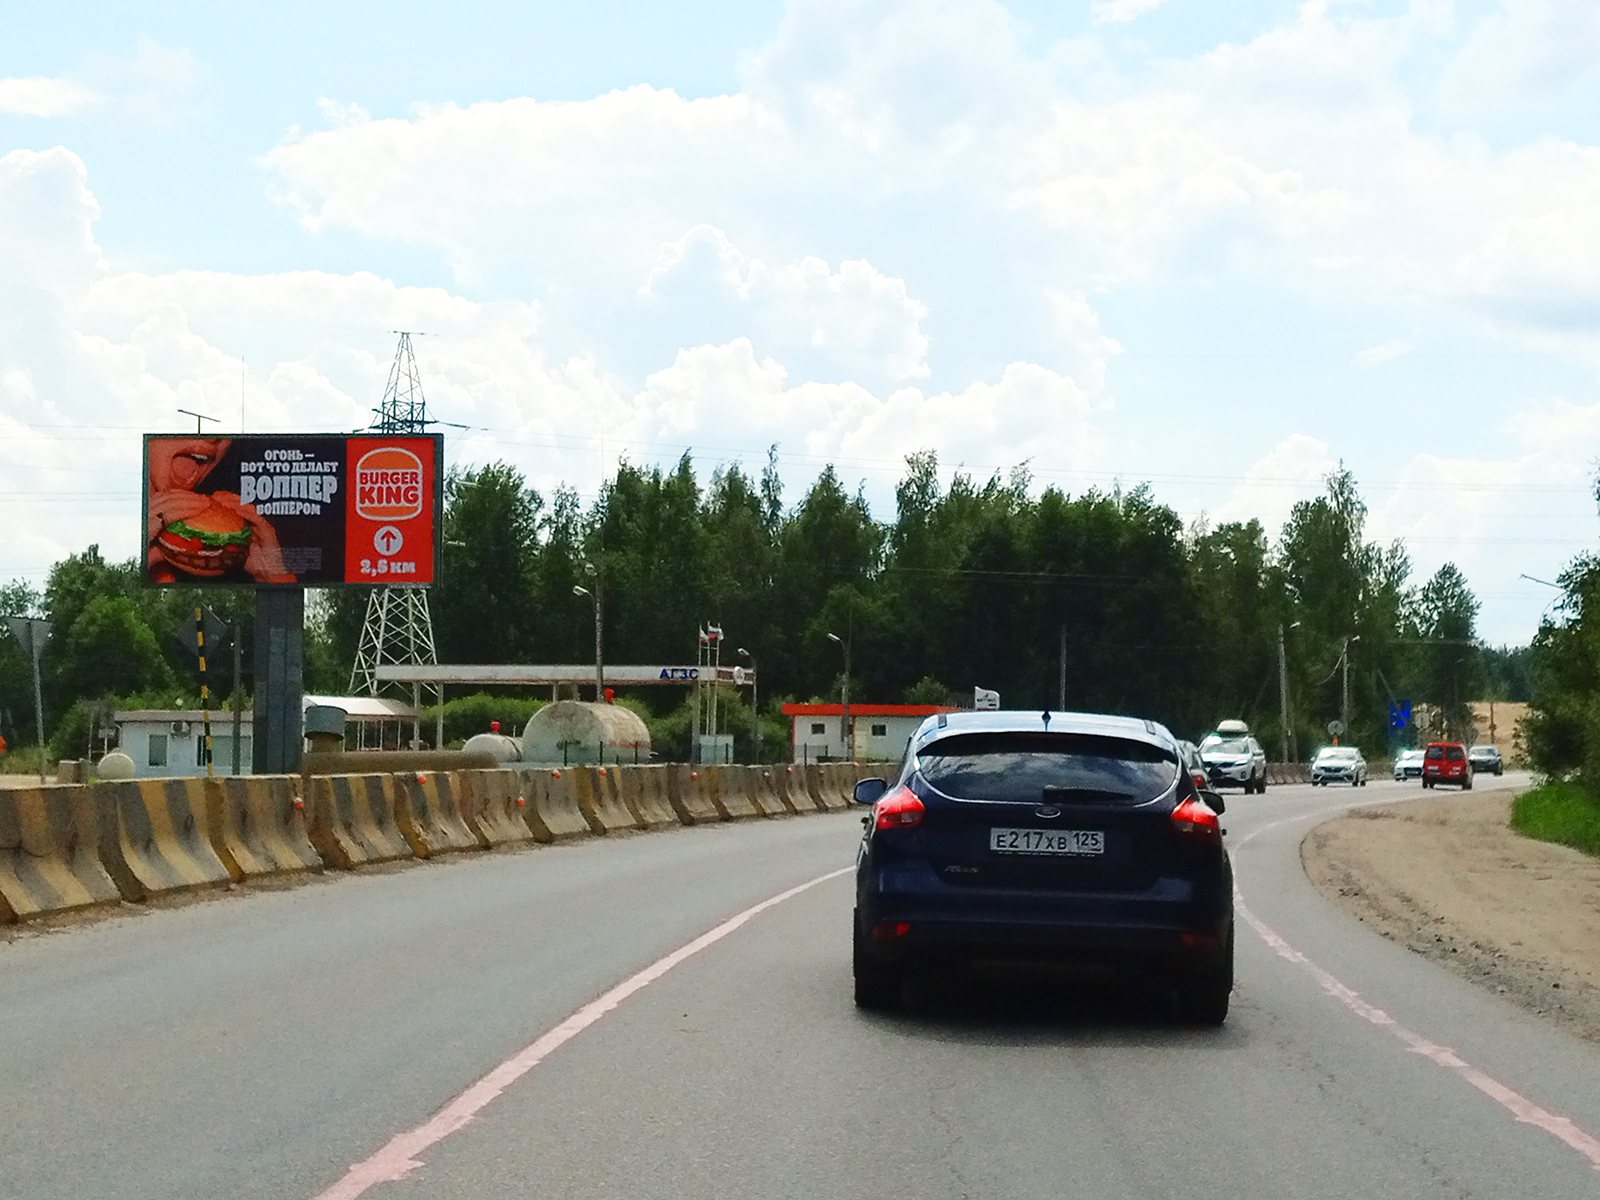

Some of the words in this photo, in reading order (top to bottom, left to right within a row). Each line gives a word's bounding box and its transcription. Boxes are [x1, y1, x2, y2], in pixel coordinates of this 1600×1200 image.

[241, 461, 265, 473] ВОТ
[265, 461, 291, 473] ЧТО
[291, 461, 339, 473] ДЕЛАЕТ
[359, 471, 419, 485] BURGER
[240, 475, 338, 505] ВОППЕР
[359, 485, 419, 505] KING
[256, 501, 321, 515] ВОППЕРОМ
[659, 668, 699, 680] АГЗС
